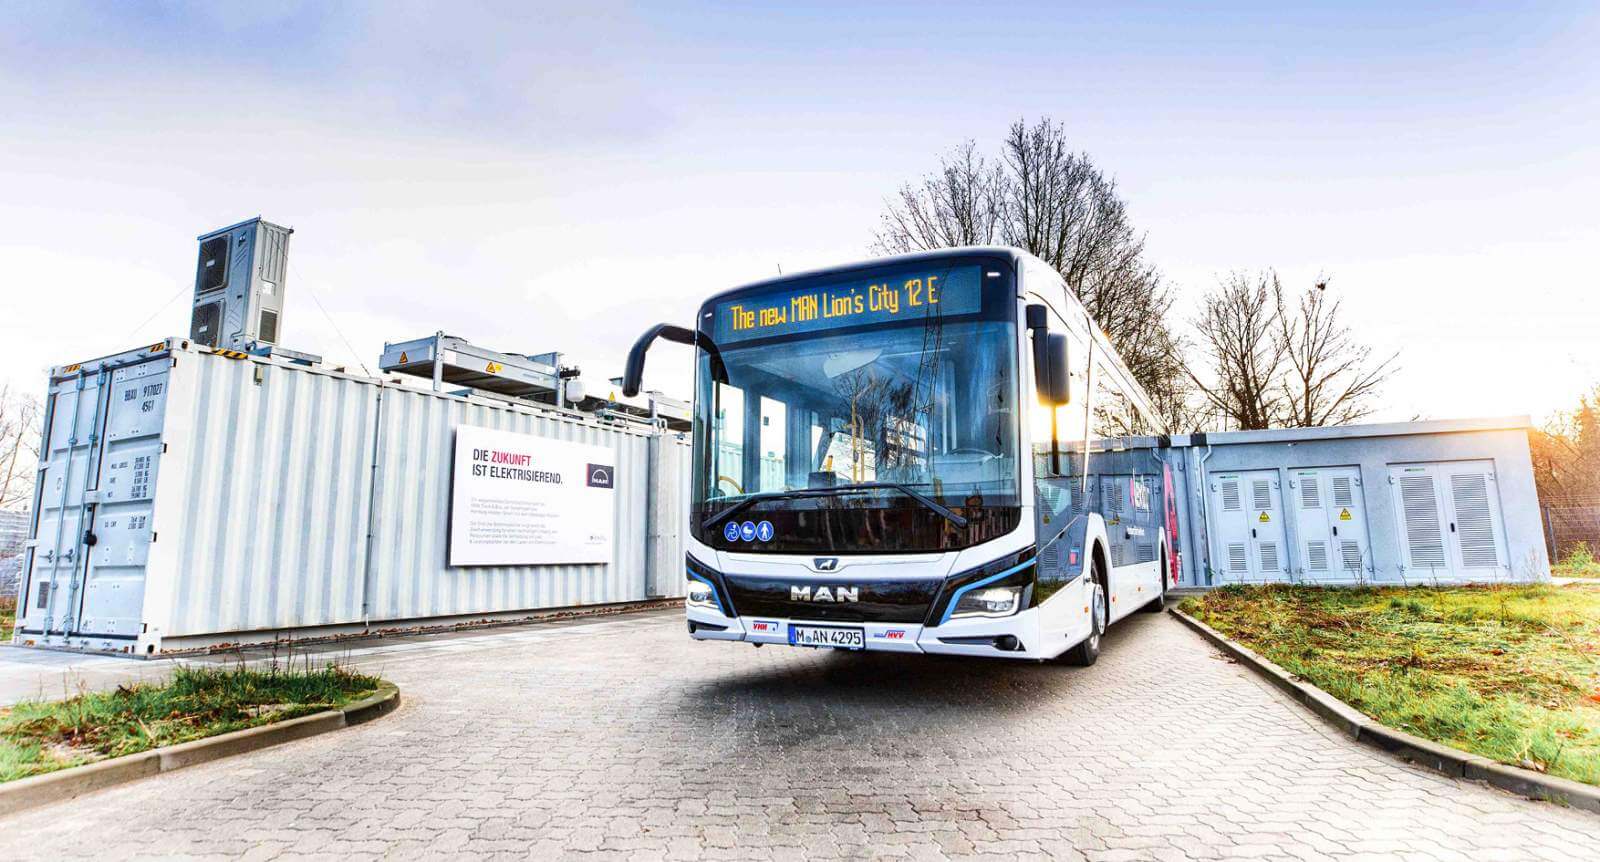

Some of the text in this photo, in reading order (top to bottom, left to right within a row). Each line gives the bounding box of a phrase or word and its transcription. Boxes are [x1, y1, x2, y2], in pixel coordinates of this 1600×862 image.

[730, 276, 939, 330] The new MAN Lion's City 12 E
[143, 383, 162, 397] 917027
[473, 448, 532, 467] DIE ZUKUNFT
[472, 463, 563, 485] IST ELEKTRISIEREND.
[790, 585, 859, 602] MAN
[796, 630, 862, 646] M AN 4295
